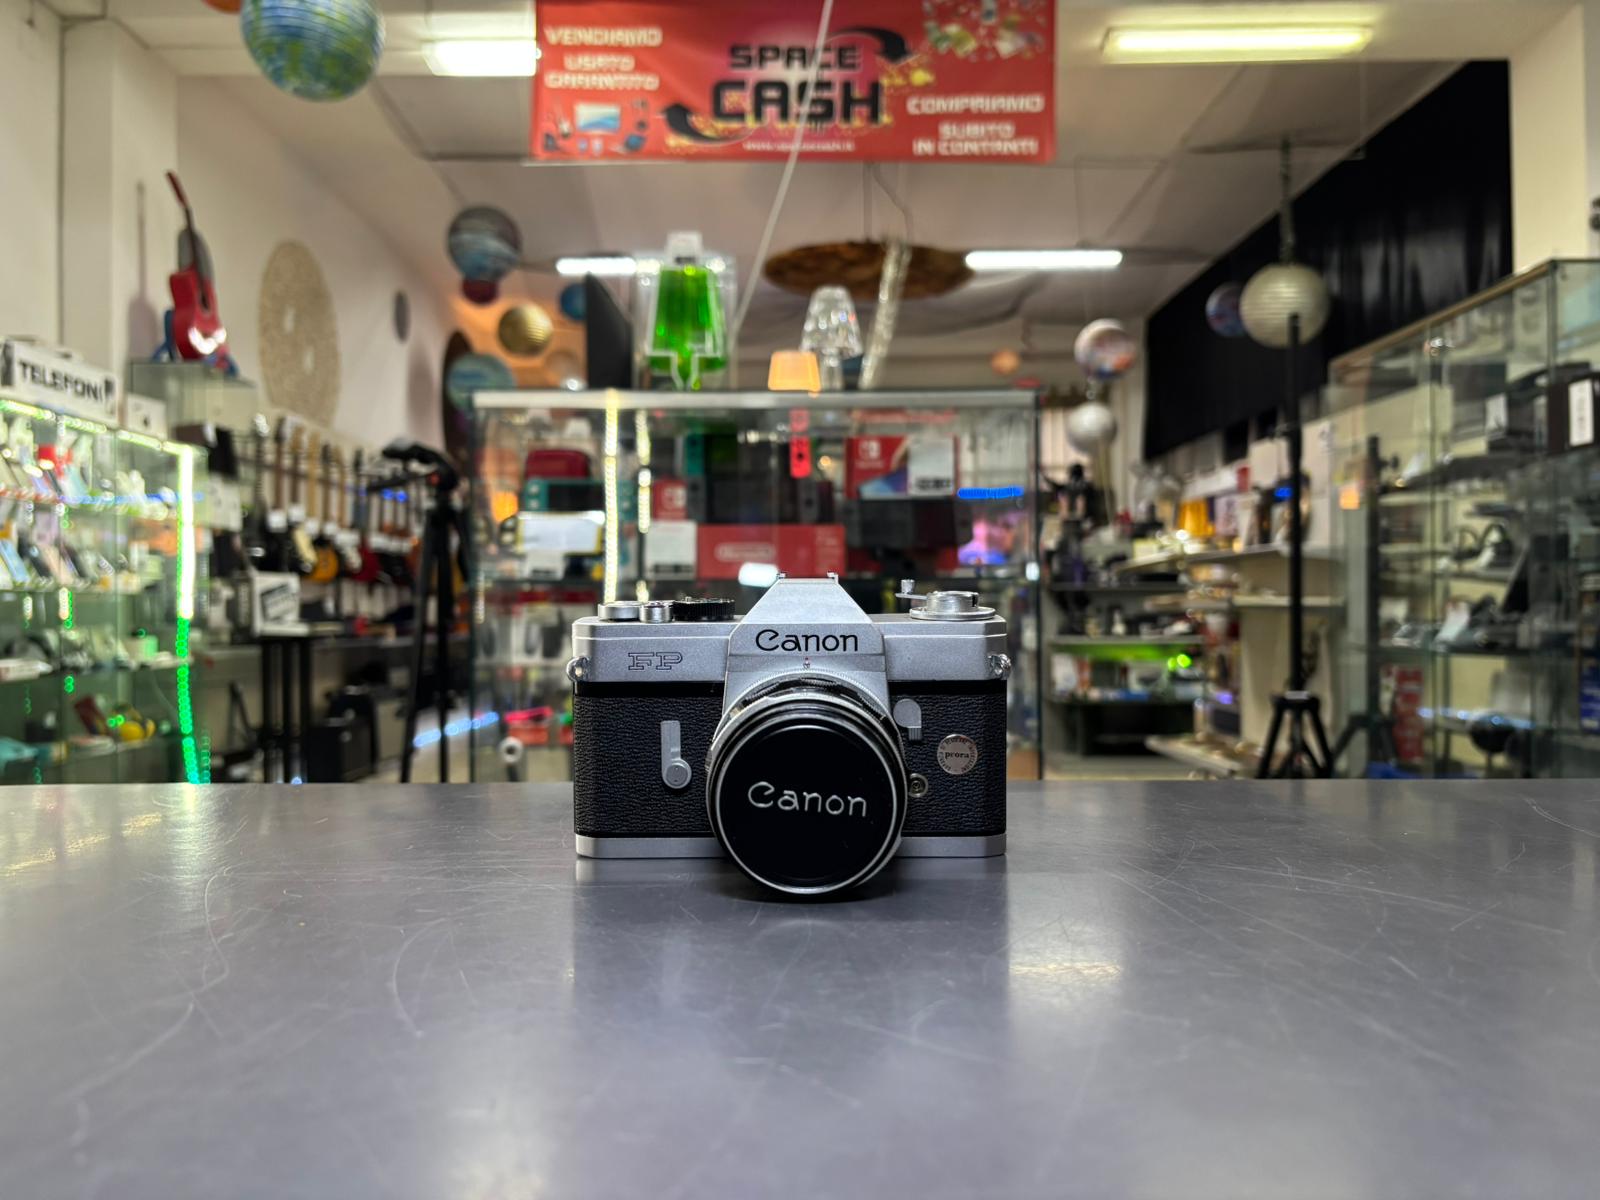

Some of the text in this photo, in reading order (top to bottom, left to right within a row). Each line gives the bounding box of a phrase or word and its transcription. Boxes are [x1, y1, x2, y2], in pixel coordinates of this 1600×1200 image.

[544, 26, 662, 47] VENDIAMO
[730, 45, 860, 69] SPACE
[713, 80, 882, 124] CASH
[906, 95, 1045, 114] COMPRIAMO
[912, 139, 935, 155] IN
[19, 359, 104, 402] TELEFONI
[755, 628, 859, 653] Canon
[627, 651, 683, 671] FP
[747, 781, 867, 817] Canon
